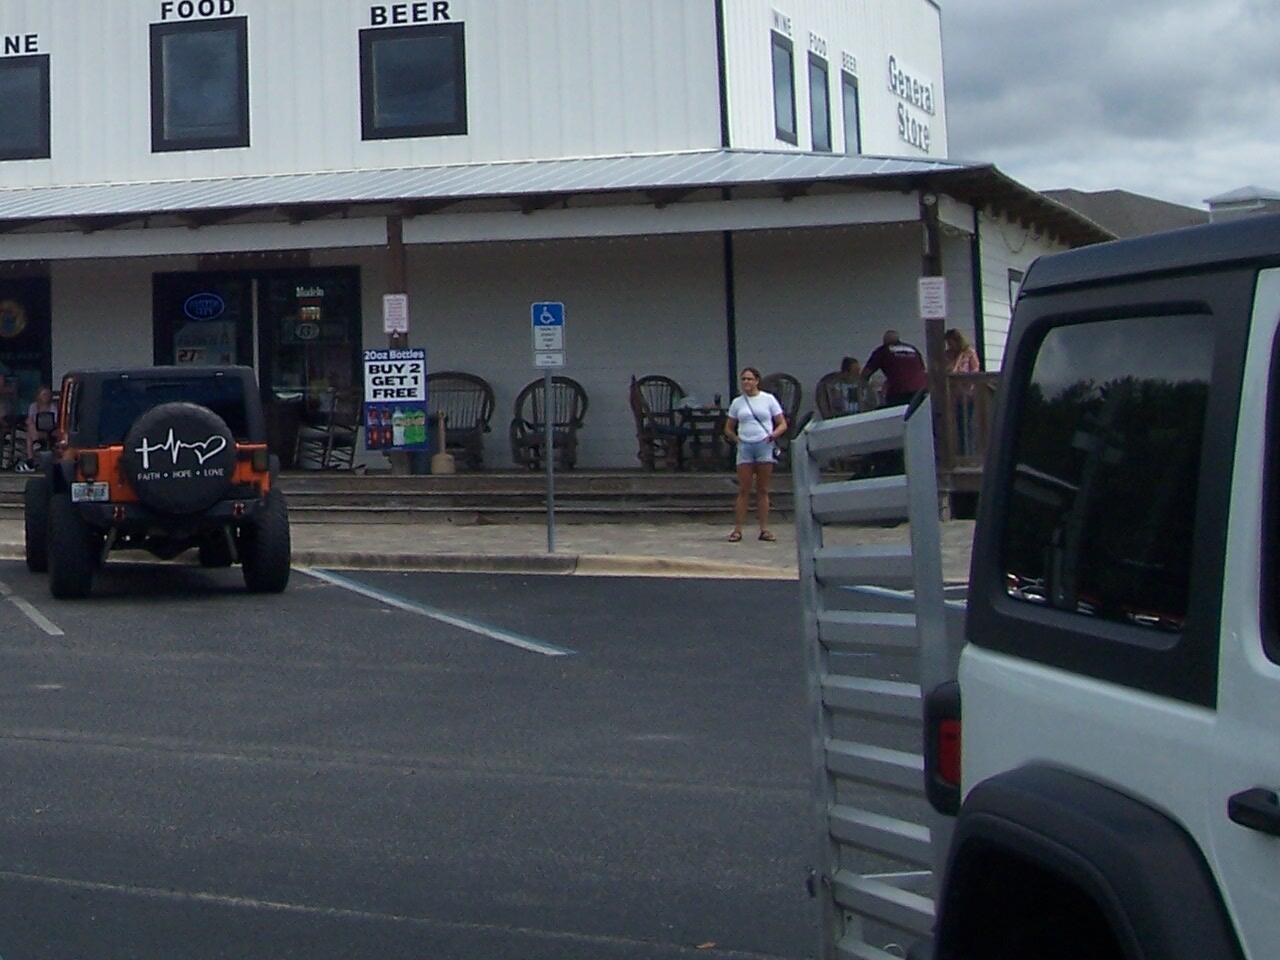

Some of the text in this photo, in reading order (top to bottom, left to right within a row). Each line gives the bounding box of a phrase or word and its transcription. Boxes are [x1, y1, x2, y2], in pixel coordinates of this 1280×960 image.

[369, 0, 452, 26] BEER
[809, 31, 827, 57] FOOD
[841, 50, 856, 71] BEER
[888, 54, 935, 116] General
[897, 101, 930, 153] Store
[364, 349, 424, 360] 20oz Bottles
[368, 363, 421, 374] BUY 2
[371, 375, 418, 386] GET 1
[372, 388, 418, 398] FREE
[137, 468, 225, 480] FAITH HOPE LOVE
